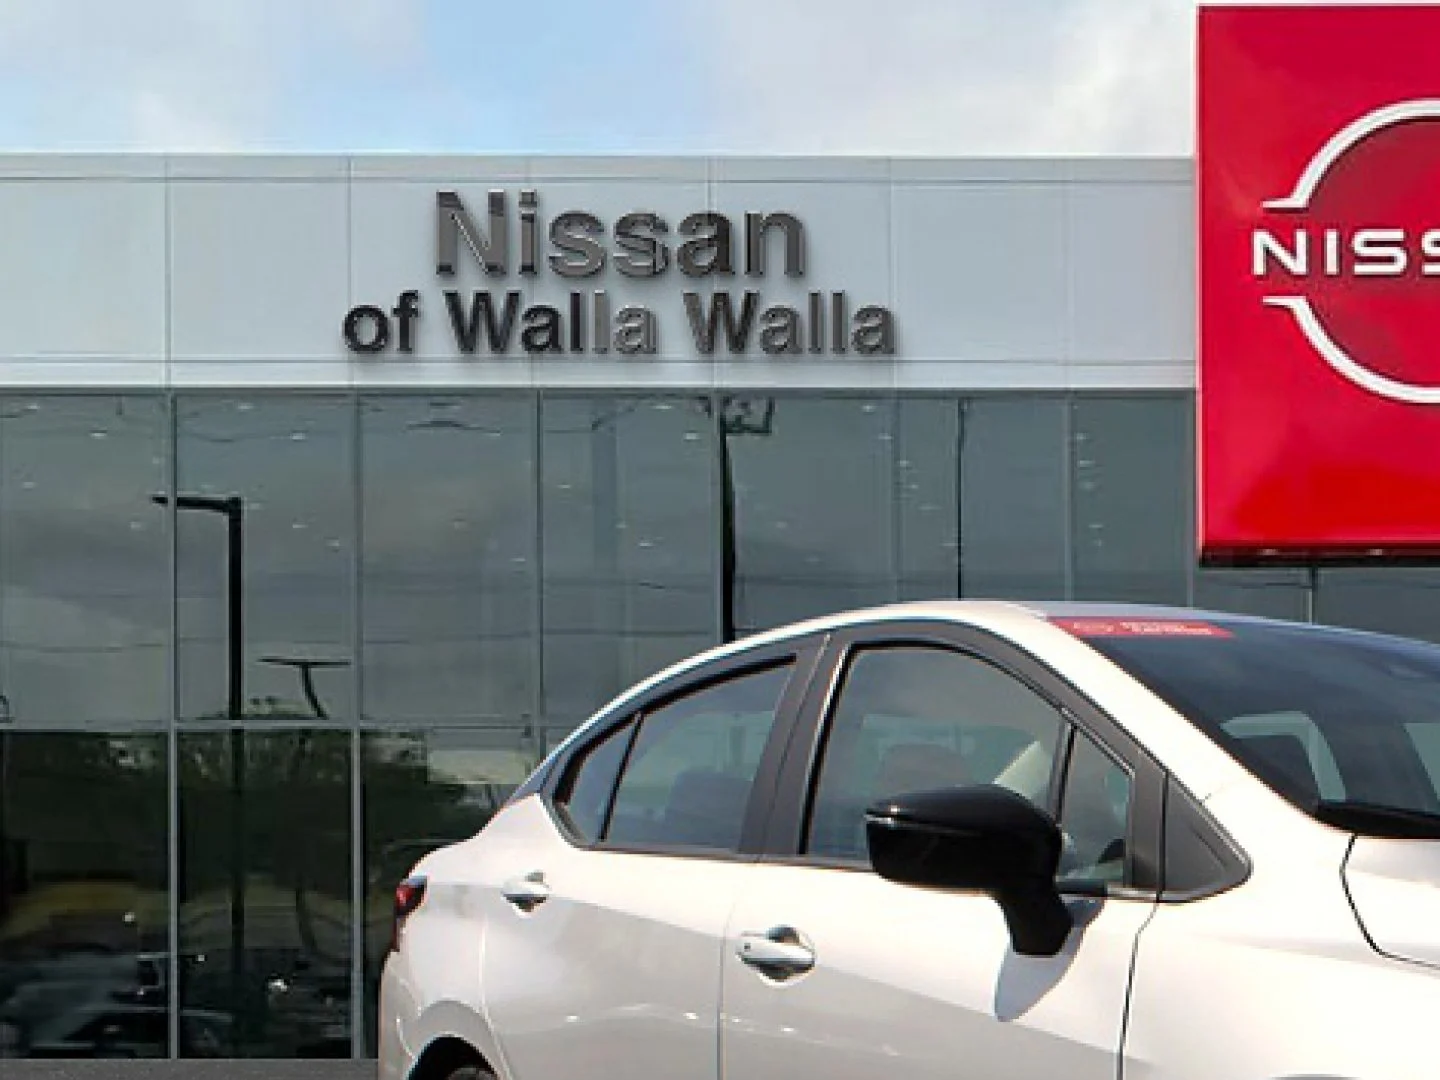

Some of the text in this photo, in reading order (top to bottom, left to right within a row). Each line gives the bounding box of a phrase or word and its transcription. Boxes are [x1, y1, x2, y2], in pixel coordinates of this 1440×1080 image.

[435, 189, 806, 277] Nissan
[342, 289, 896, 355] of Walla Walla
